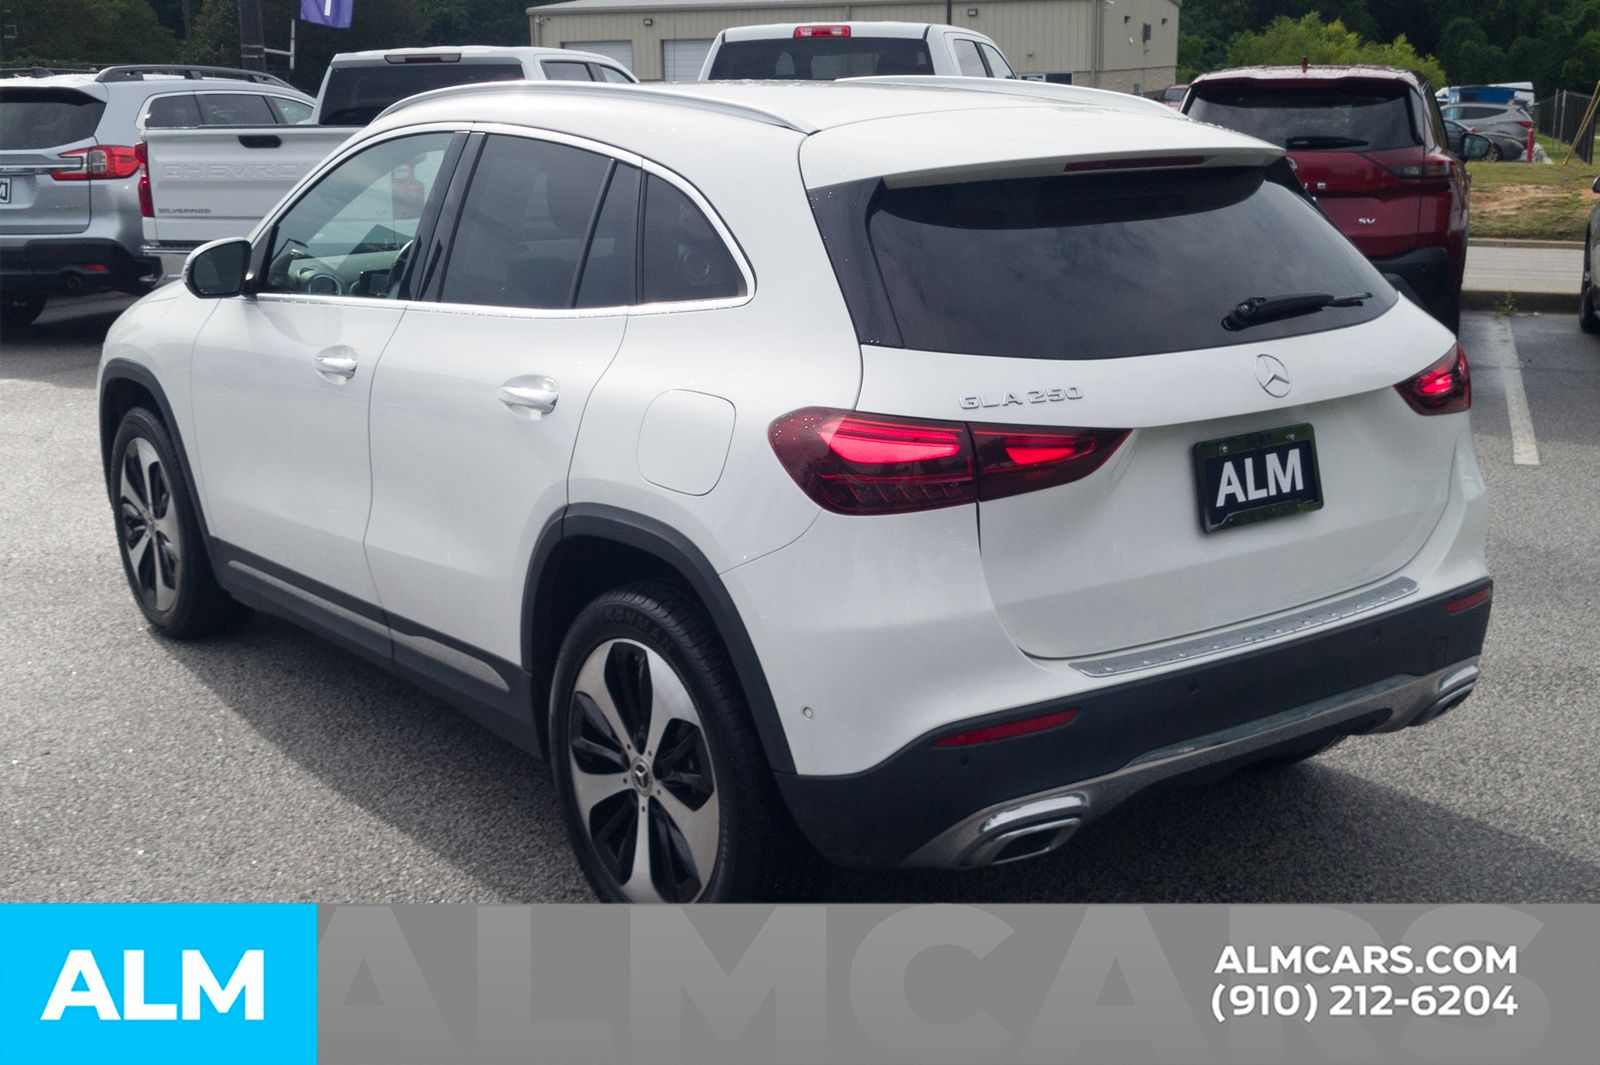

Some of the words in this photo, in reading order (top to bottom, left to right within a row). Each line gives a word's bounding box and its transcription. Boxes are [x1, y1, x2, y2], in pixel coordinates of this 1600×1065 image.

[959, 391, 1024, 410] GLA
[1027, 386, 1084, 404] 250
[1215, 447, 1305, 508] ALM
